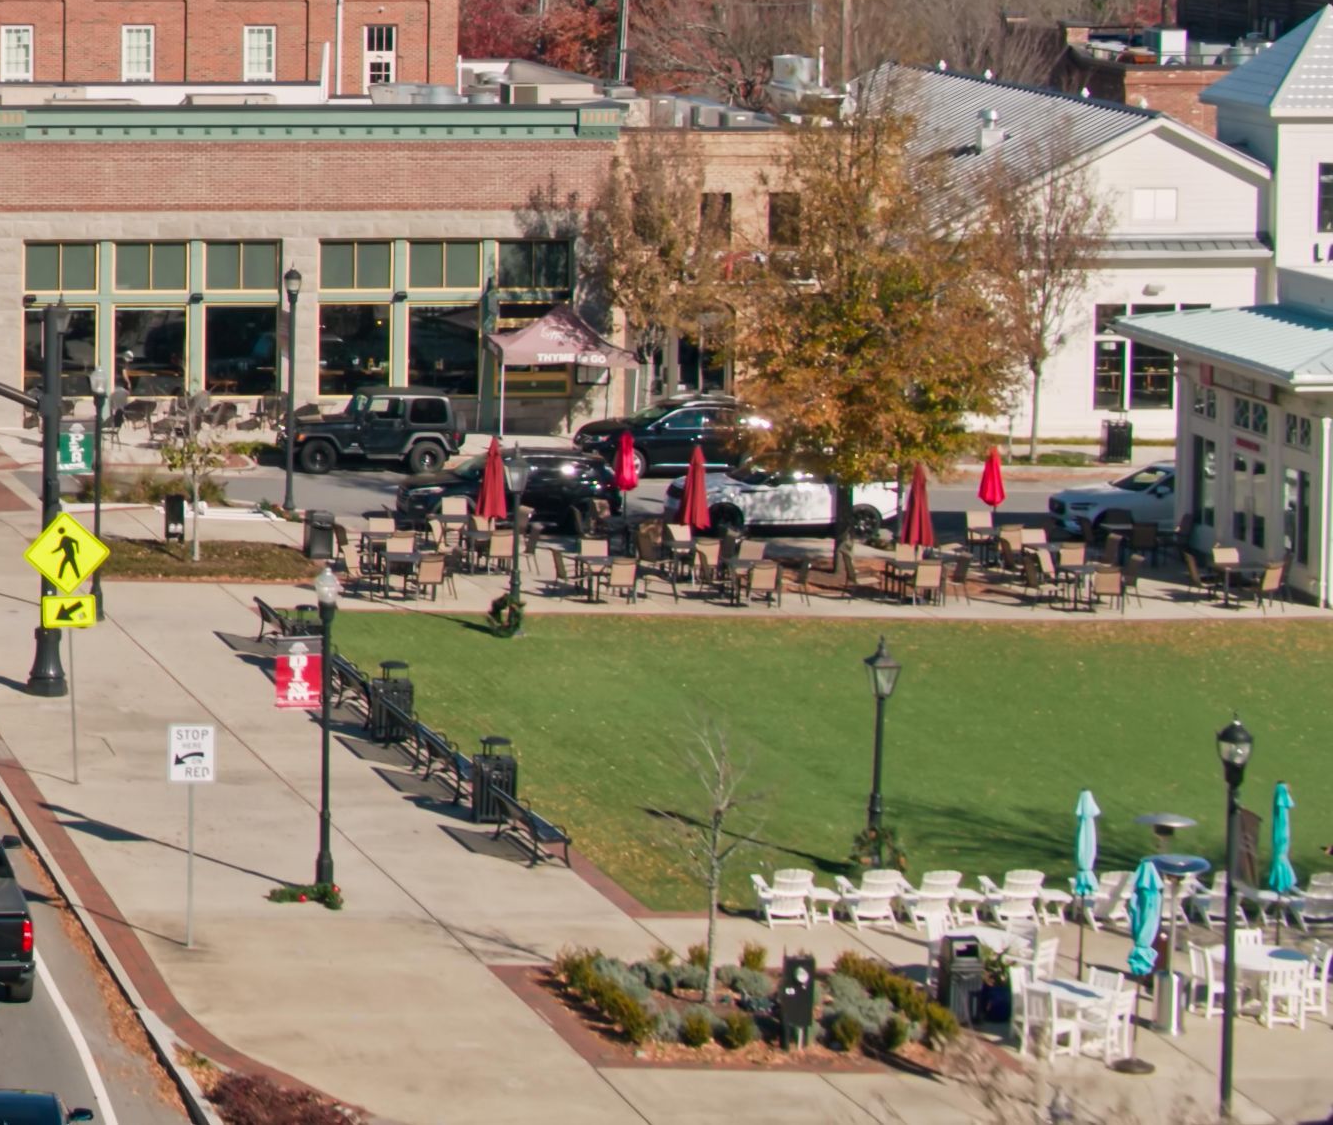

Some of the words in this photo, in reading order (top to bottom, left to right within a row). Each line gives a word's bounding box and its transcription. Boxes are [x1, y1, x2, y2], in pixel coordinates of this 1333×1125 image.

[537, 353, 575, 363] THYME
[590, 355, 606, 364] GO
[176, 729, 209, 741] STOP
[184, 766, 210, 778] RED
